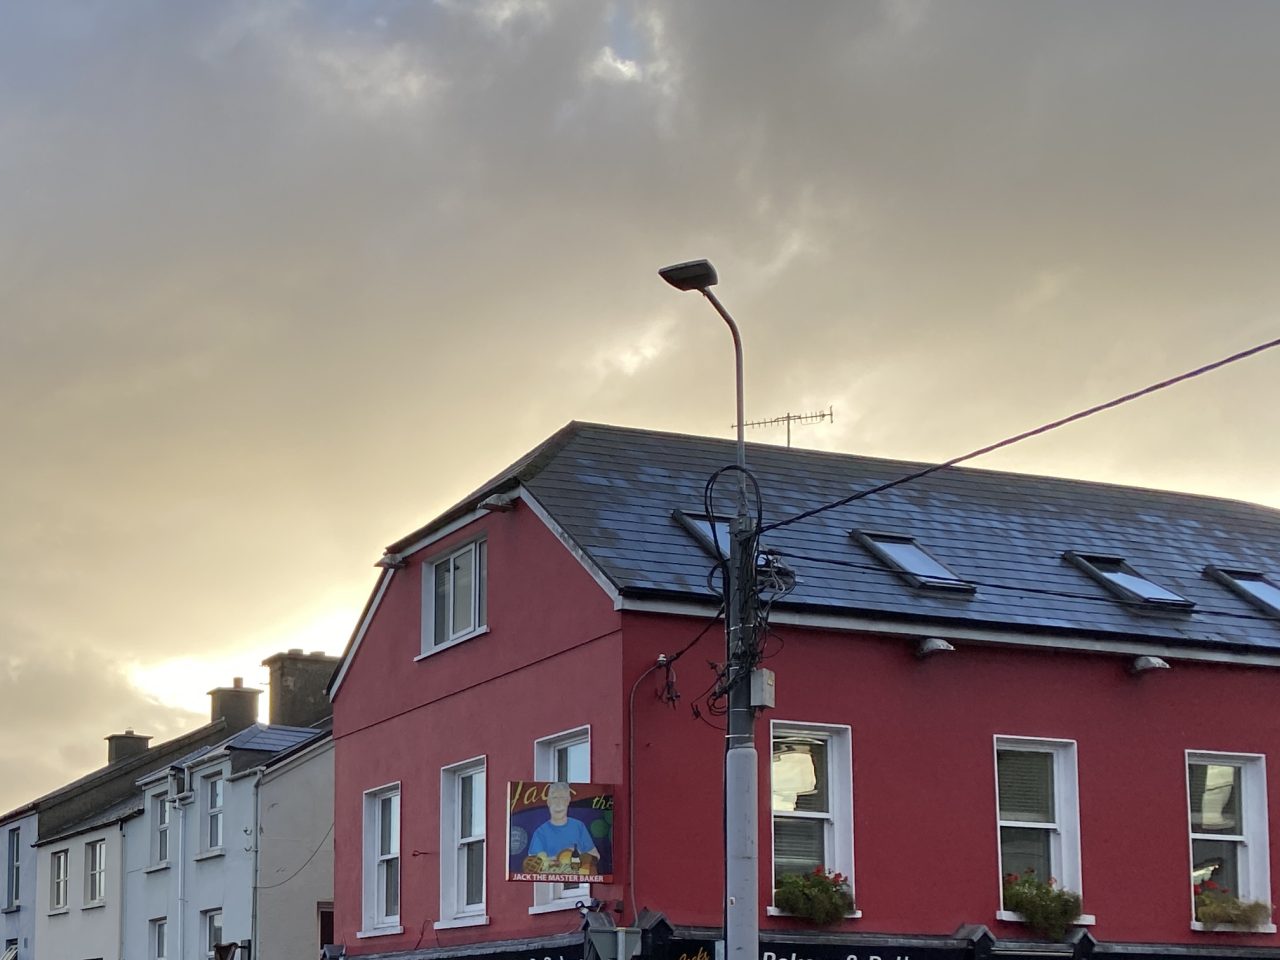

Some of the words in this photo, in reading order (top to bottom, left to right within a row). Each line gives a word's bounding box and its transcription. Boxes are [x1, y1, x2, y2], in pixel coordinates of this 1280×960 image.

[513, 873, 531, 881] JACK
[548, 874, 578, 882] MASTER
[579, 875, 604, 883] BAKER
